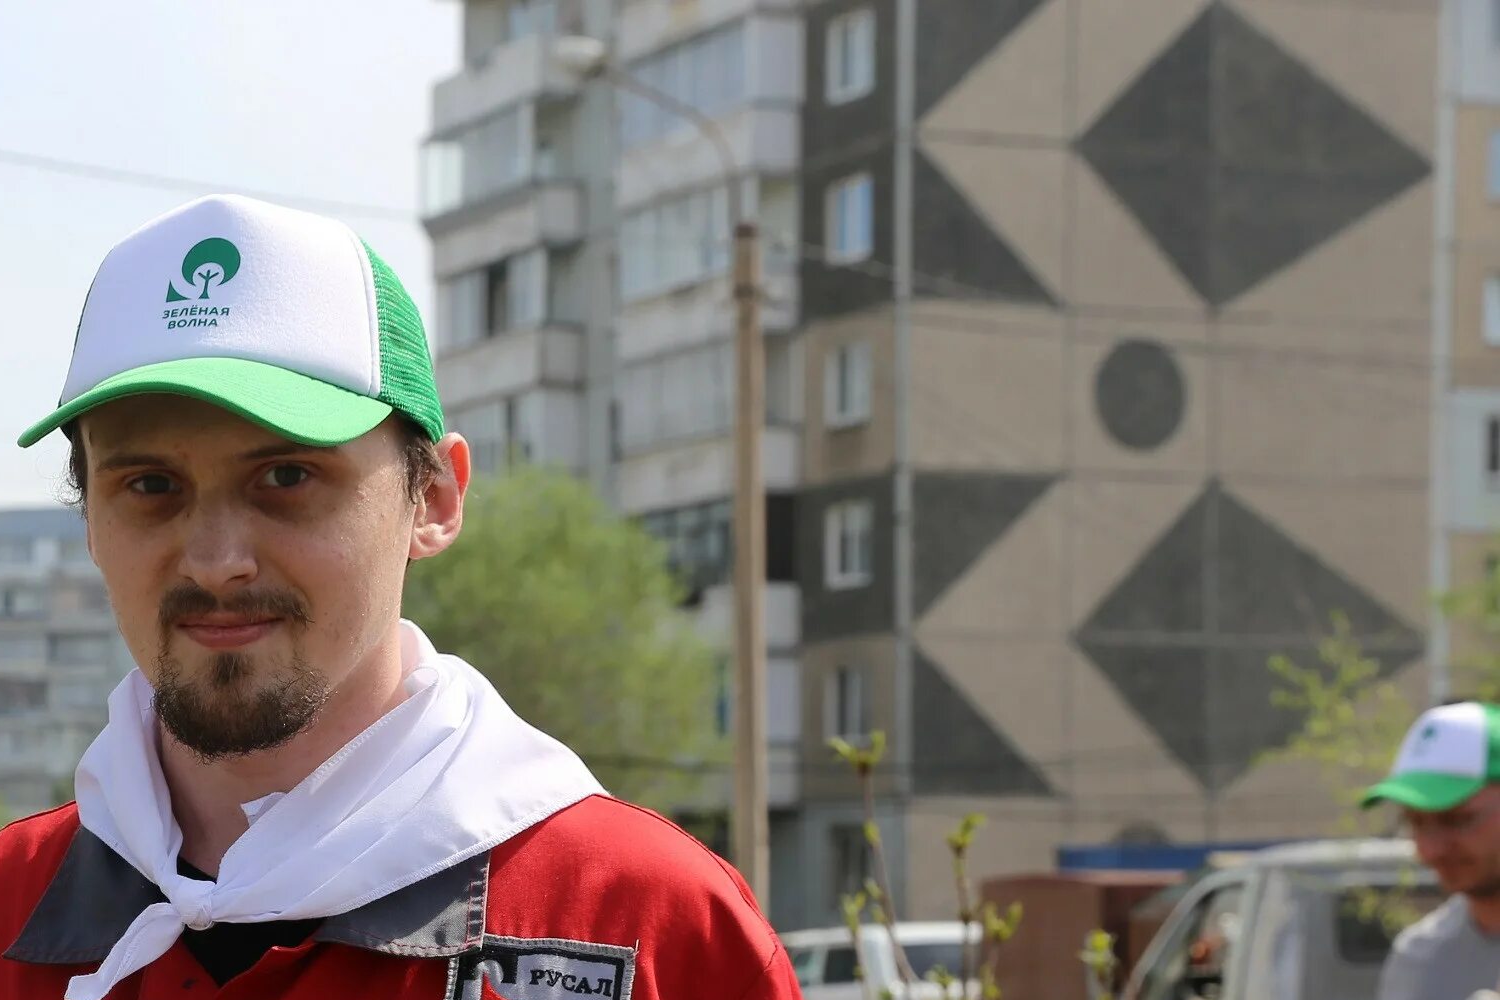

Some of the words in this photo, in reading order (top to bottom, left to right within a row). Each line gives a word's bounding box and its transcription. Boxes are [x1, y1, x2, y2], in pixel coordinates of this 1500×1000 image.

[162, 304, 230, 319] ЗЕЛЁНАЯ
[167, 318, 219, 330] ВОЛНА
[529, 969, 614, 998] РУСАЛ
